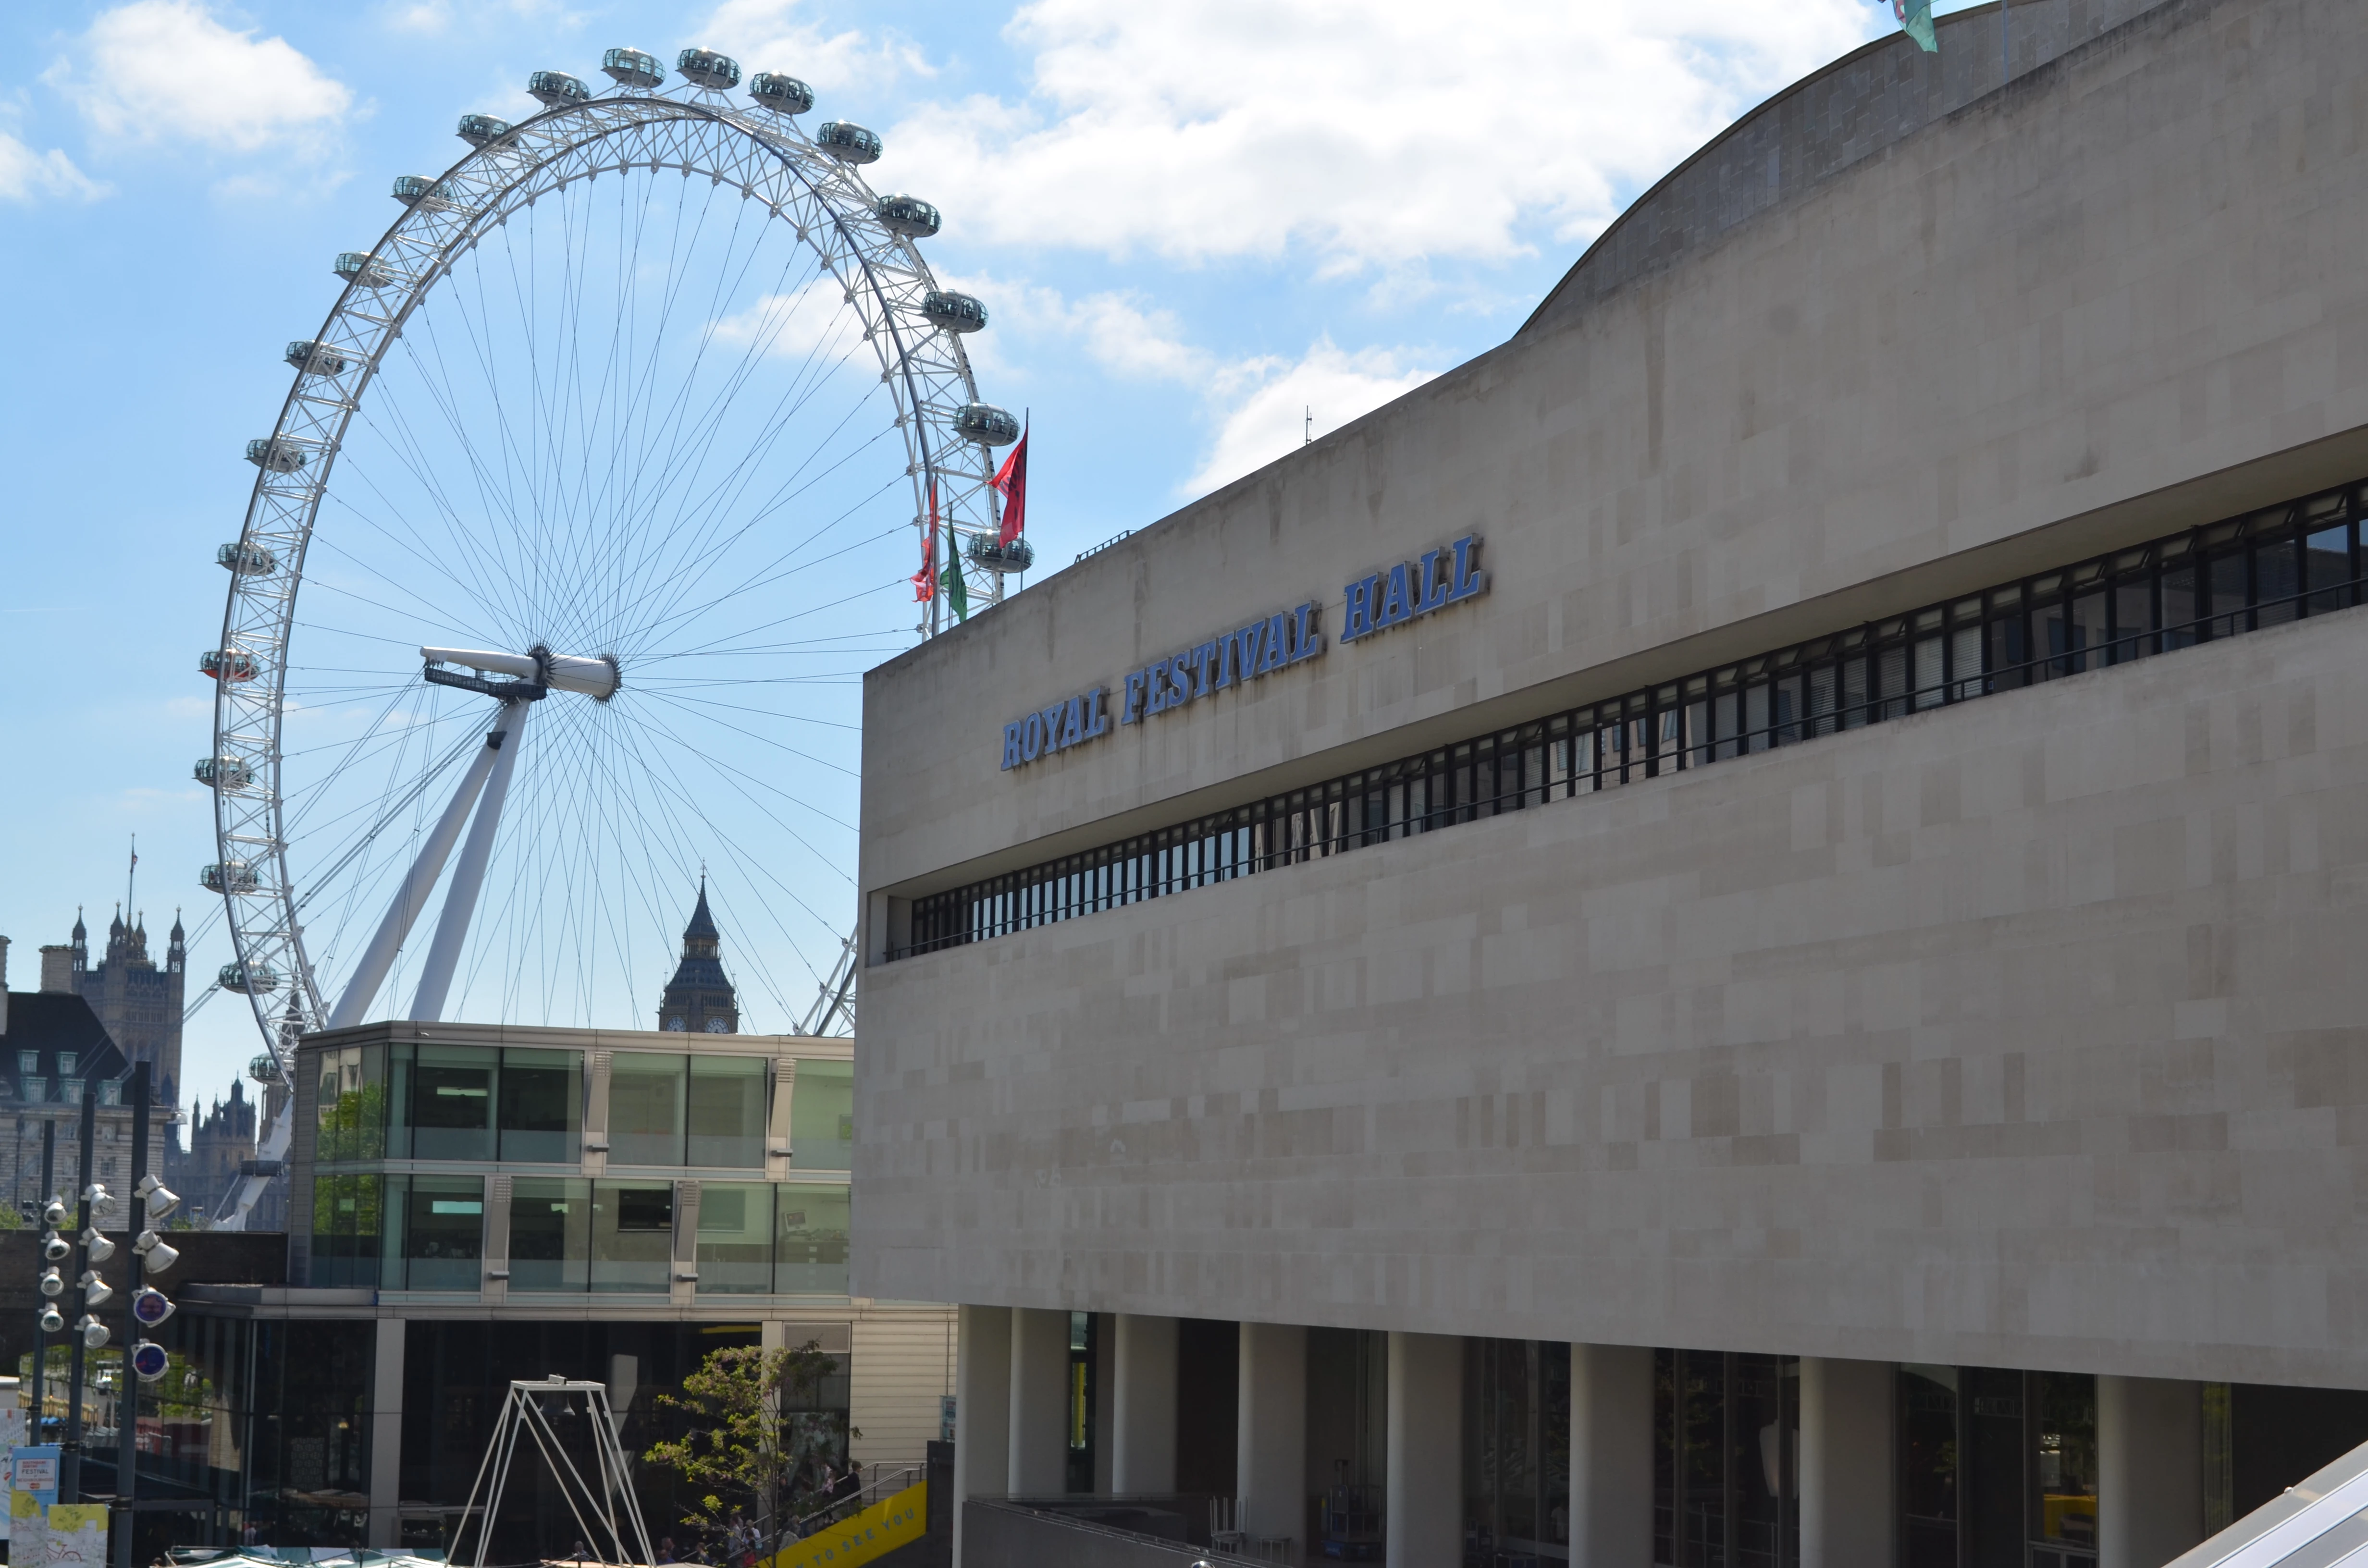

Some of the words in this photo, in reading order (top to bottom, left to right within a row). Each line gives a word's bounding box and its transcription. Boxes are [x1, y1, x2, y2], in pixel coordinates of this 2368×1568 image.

[1001, 687, 1106, 772] ROYAL
[1122, 601, 1321, 726] FESTIVAL
[1340, 533, 1482, 644] HALL
[813, 1549, 834, 1566] TO
[842, 1528, 875, 1552] SEE
[881, 1508, 914, 1531] YOU
